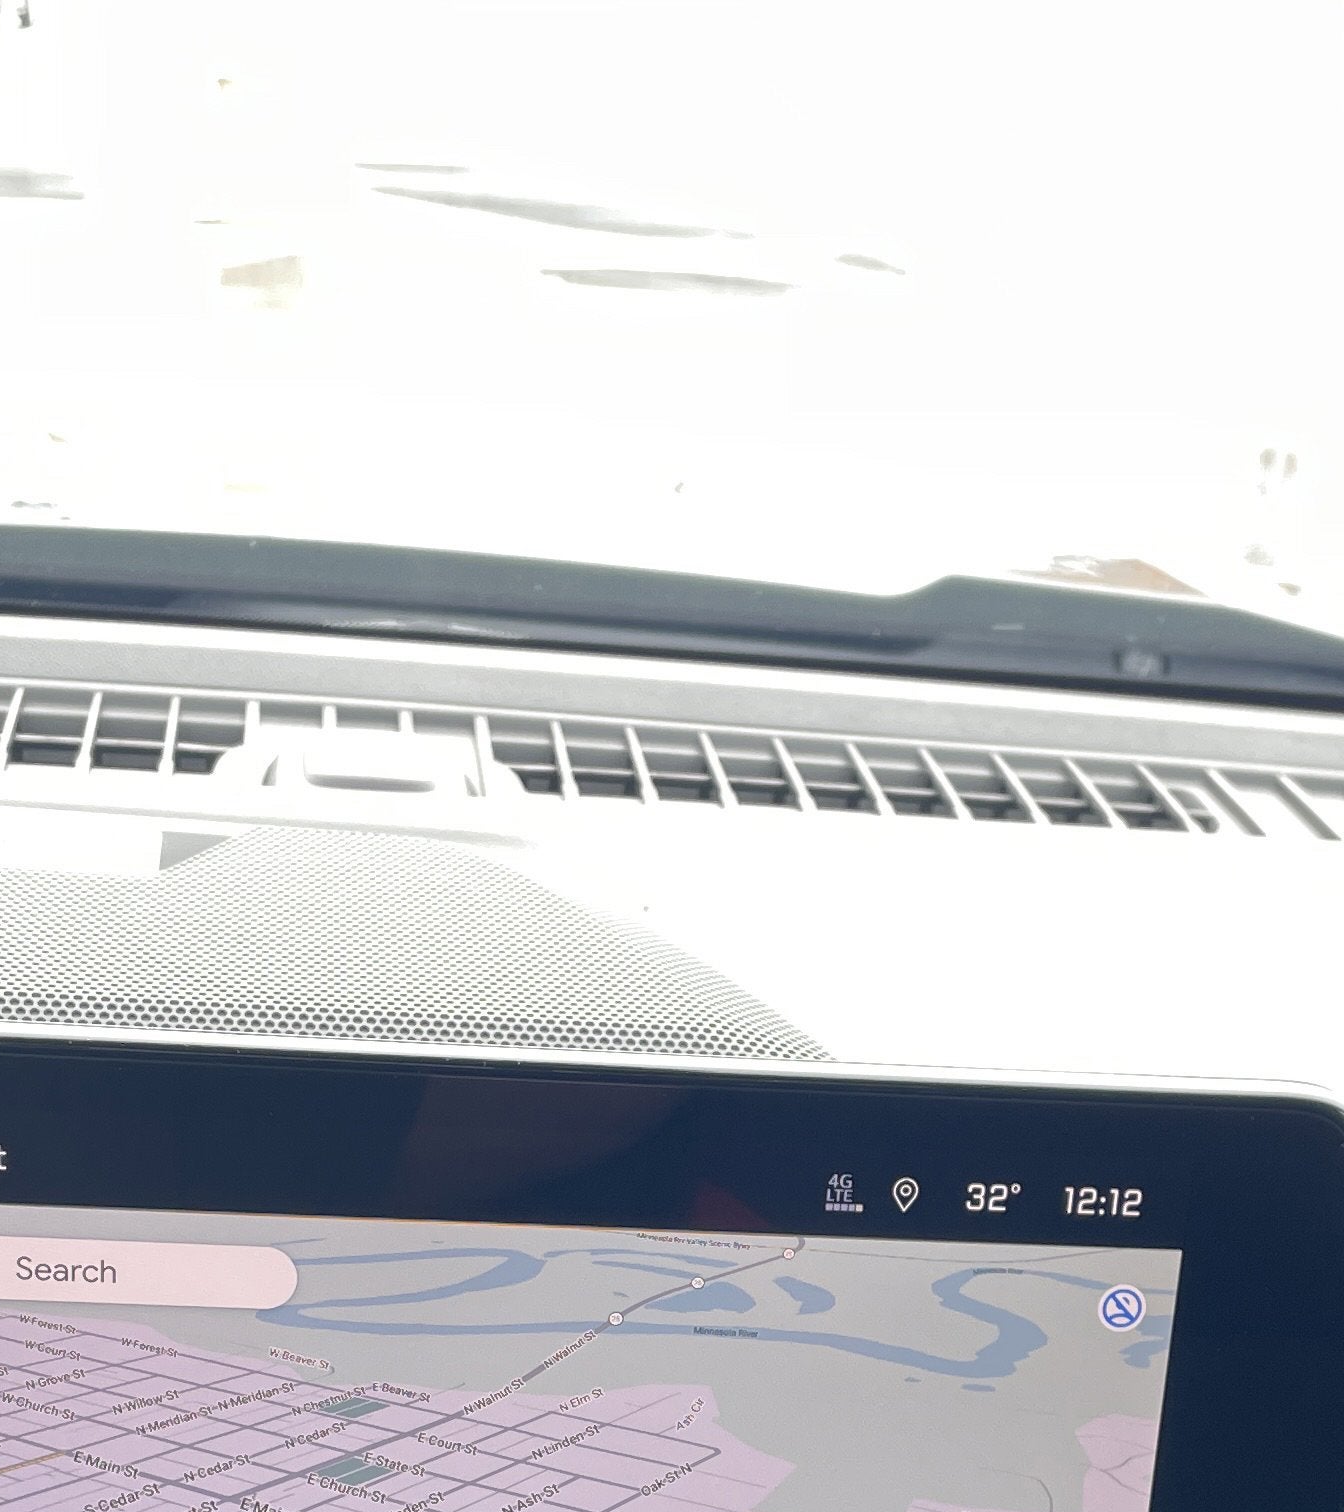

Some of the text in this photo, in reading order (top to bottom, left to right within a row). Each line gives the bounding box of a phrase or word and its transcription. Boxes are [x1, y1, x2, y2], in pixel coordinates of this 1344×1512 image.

[826, 1189, 853, 1202] LTE
[828, 1174, 853, 1188] 4G
[966, 1183, 1021, 1212] 32°
[1064, 1187, 1142, 1216] 12:12
[15, 1255, 117, 1284] Search
